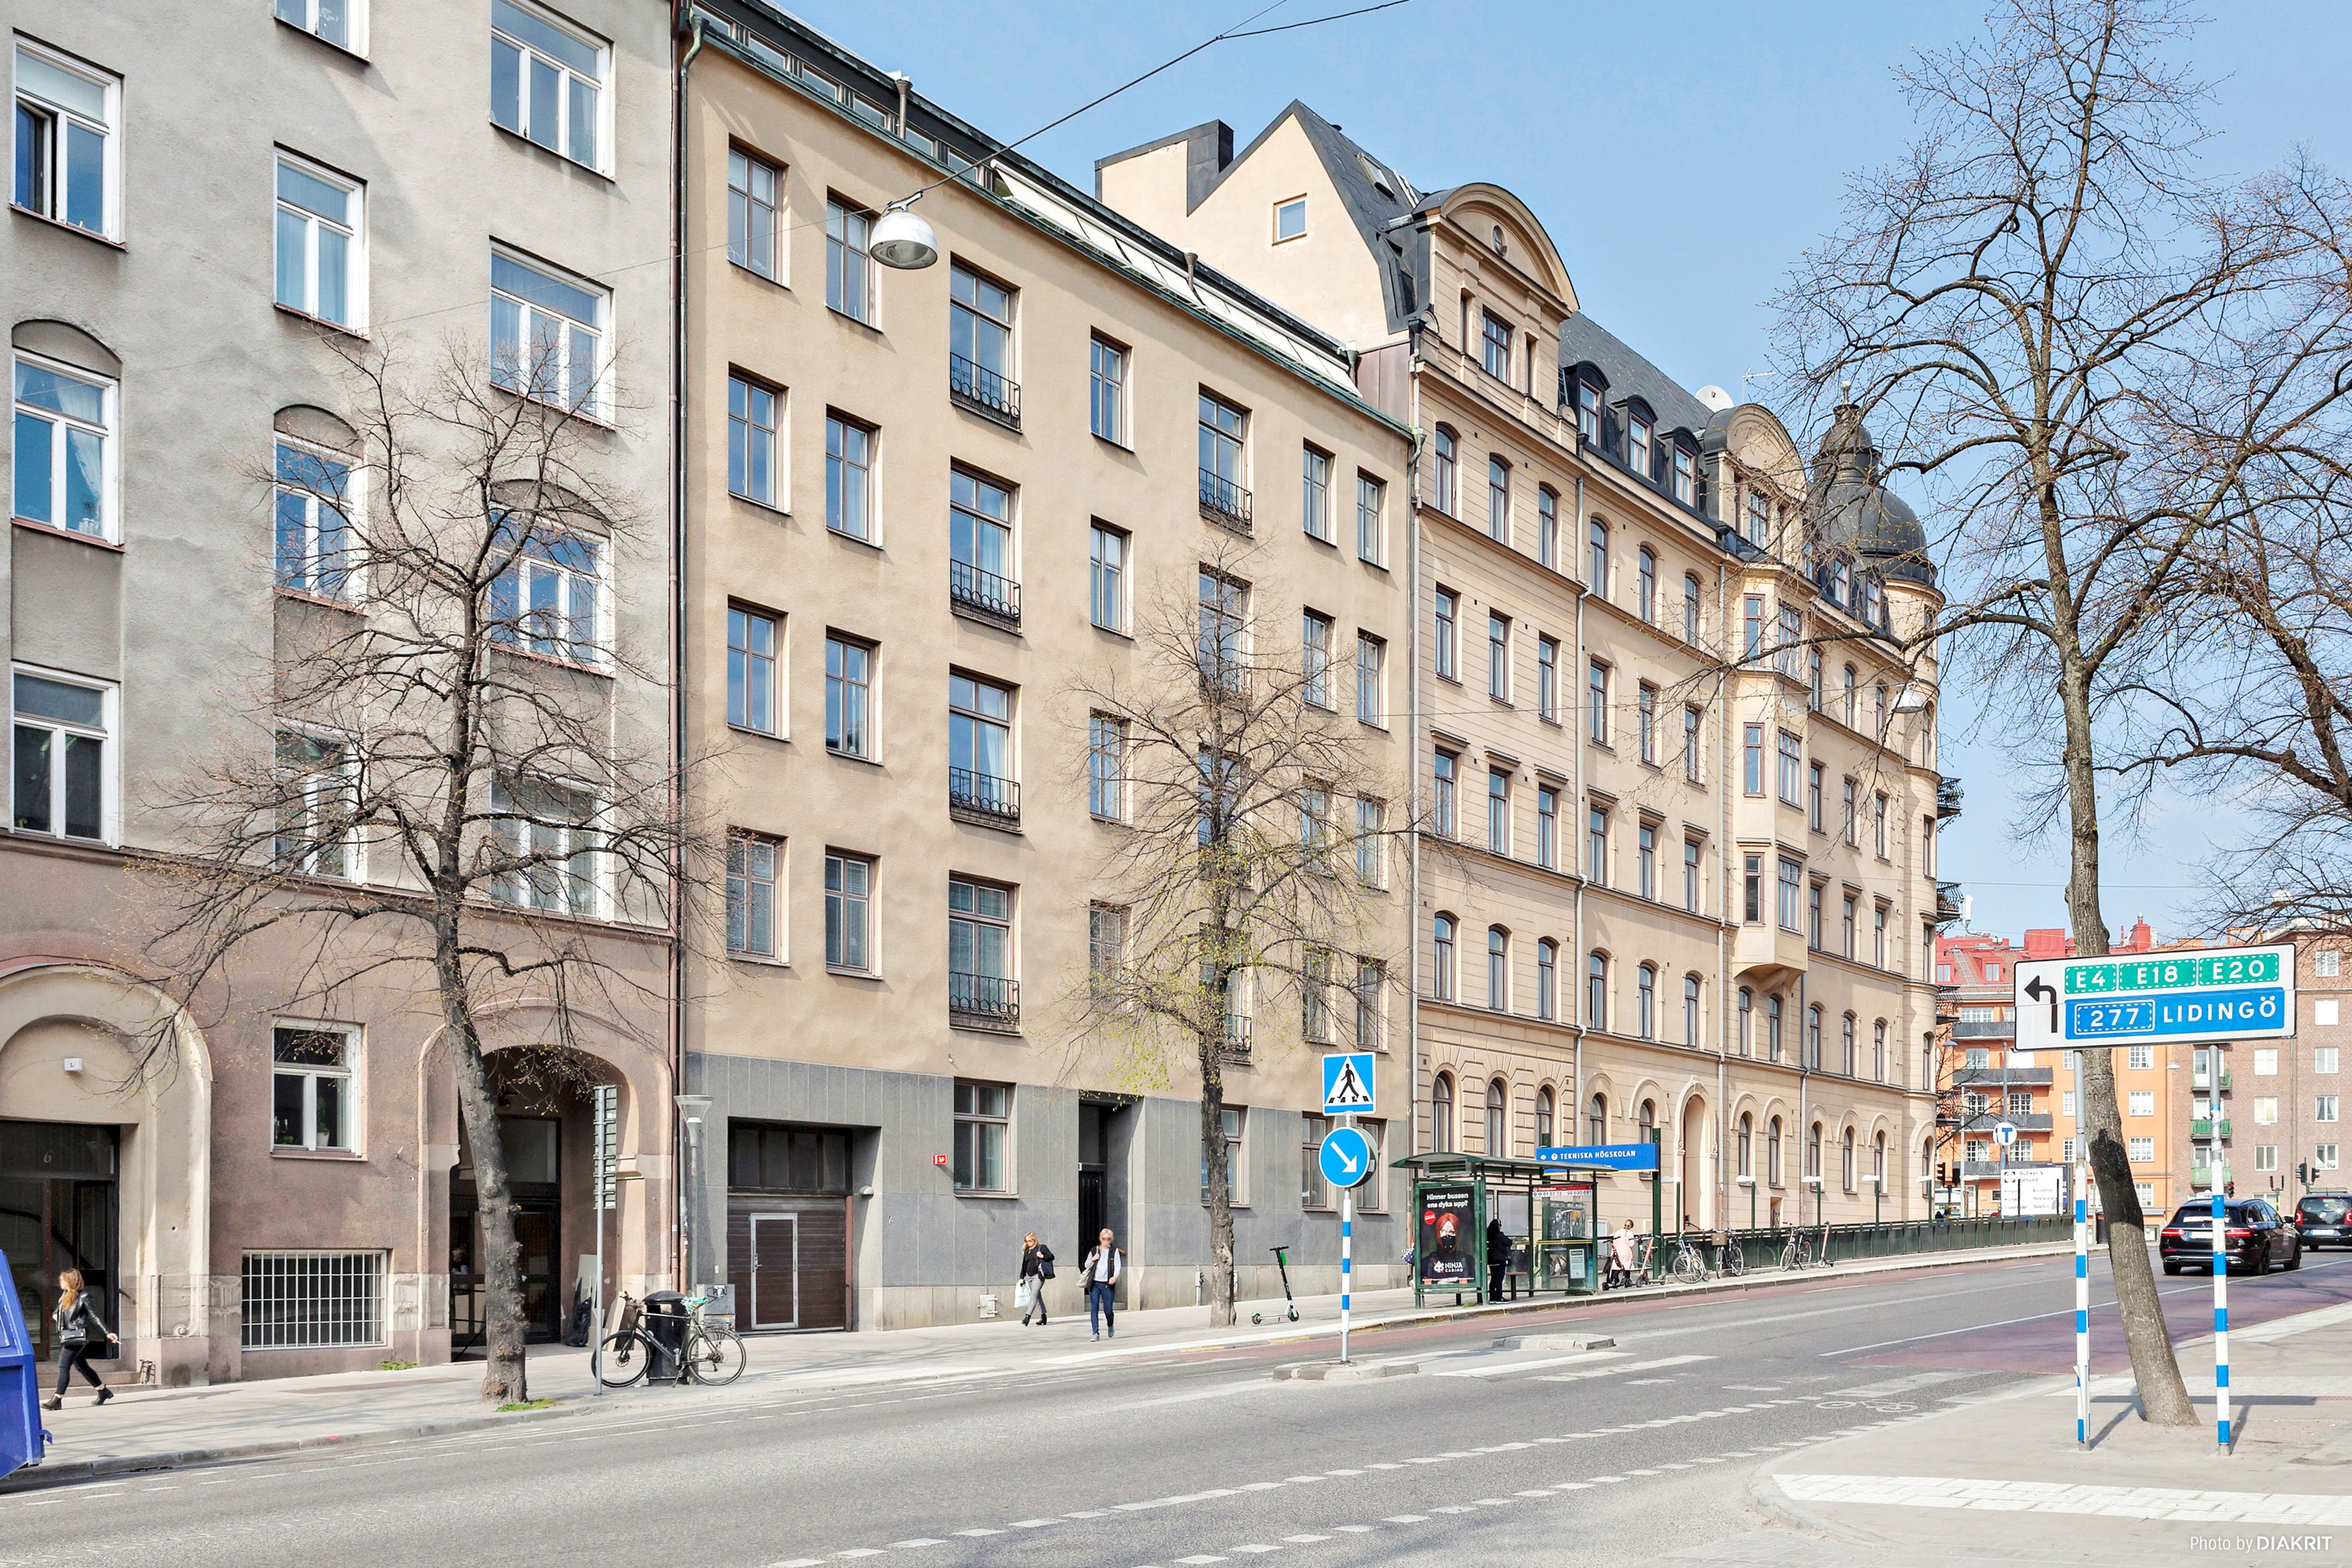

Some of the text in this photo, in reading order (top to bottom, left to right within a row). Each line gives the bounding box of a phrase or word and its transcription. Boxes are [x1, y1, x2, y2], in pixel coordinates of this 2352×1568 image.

[2076, 959, 2265, 989] E4 E18 E20
[2090, 995, 2276, 1028] 277 LIDINGÖ
[2001, 1127, 2013, 1143] T
[44, 1150, 53, 1163] 6
[1595, 1150, 1636, 1159] HÖGSKOLAN
